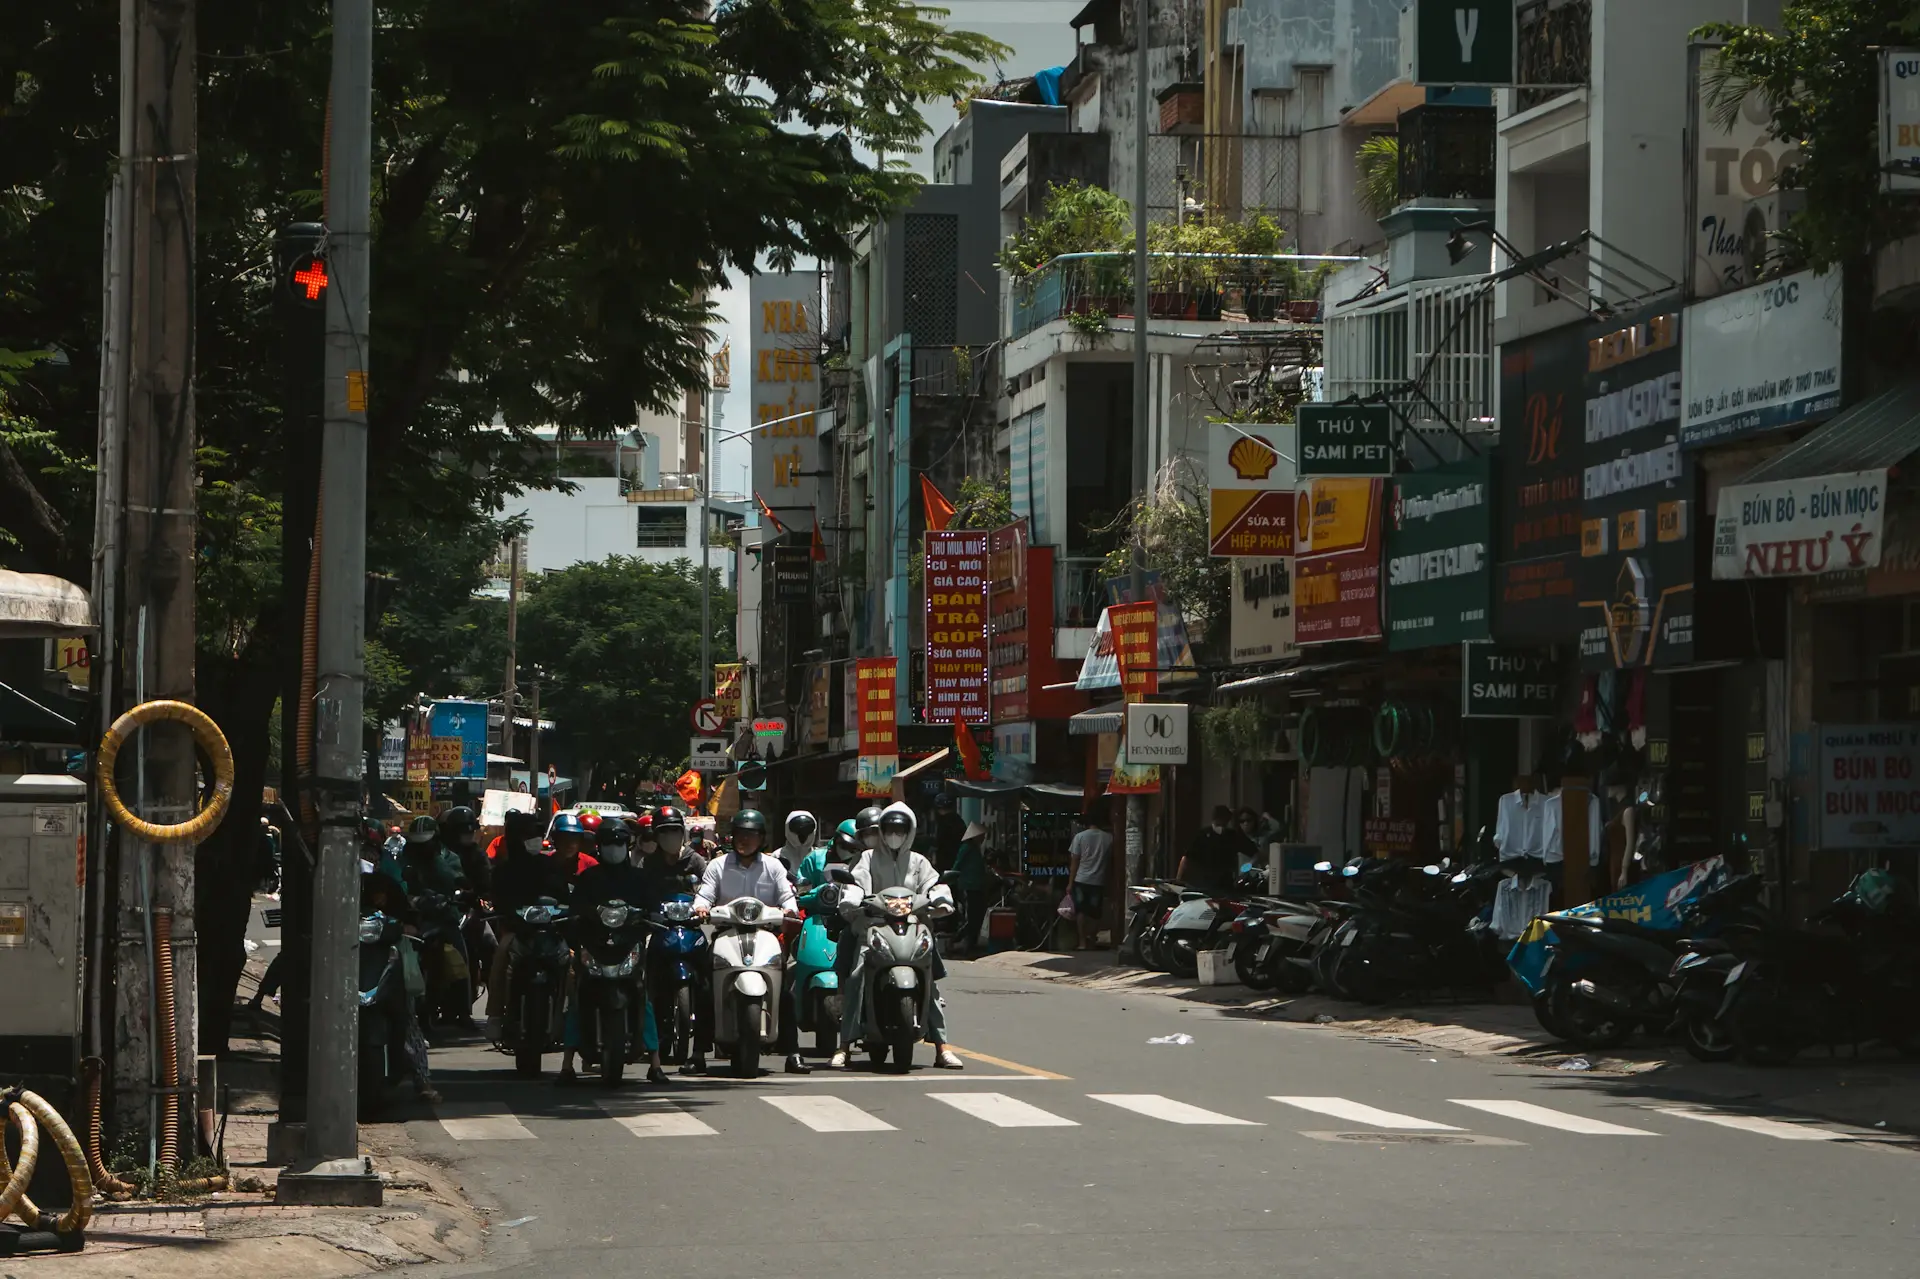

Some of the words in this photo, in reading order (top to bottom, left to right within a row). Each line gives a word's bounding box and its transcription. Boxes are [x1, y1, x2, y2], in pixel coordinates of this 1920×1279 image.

[1454, 8, 1479, 63] Y
[762, 301, 808, 333] NHA
[757, 349, 815, 382] KHOA
[1317, 416, 1354, 434] THÚ
[1361, 419, 1373, 433] Y
[1303, 445, 1346, 460] SAMI
[1352, 445, 1386, 459] PET
[1743, 493, 1771, 526] BÚN
[1776, 489, 1796, 522] BÒ
[1811, 485, 1841, 519] BÚN
[1845, 485, 1879, 523] MỌC
[1247, 515, 1269, 527] SỬA
[1272, 517, 1286, 527] XE
[931, 541, 945, 556] THU
[947, 541, 963, 556] MUA
[965, 538, 982, 555] MÁY
[1231, 530, 1257, 552] HIỆP
[1260, 530, 1292, 549] PHÁT
[1744, 531, 1834, 576] NHƯ
[1841, 523, 1874, 567] Ý
[932, 558, 948, 571] CŨ
[959, 558, 982, 571] MỚI
[934, 574, 954, 587] GIÁ
[957, 576, 981, 587] CAO
[933, 591, 981, 606] BÁN
[934, 609, 981, 625] TRẢ
[933, 629, 983, 643] GÓP
[933, 647, 953, 659] SỬA
[956, 647, 982, 658] CHỮA
[934, 664, 960, 673] THAY
[963, 664, 982, 673] PIN
[1487, 652, 1527, 672] THÚ
[1533, 656, 1544, 673] Y
[934, 678, 958, 688] THAY
[959, 676, 982, 688] MÀN
[717, 687, 742, 700] KEO
[938, 691, 961, 702] HÌNH
[963, 692, 979, 702] ZIN
[1472, 683, 1517, 699] SAMI
[1523, 683, 1557, 700] PET
[720, 704, 736, 718] XE
[1131, 744, 1163, 756] HUỲNH
[436, 762, 455, 770] XE
[1833, 750, 1877, 781] BÚN
[1826, 784, 1869, 815] BÚN
[1031, 866, 1055, 876] THAY
